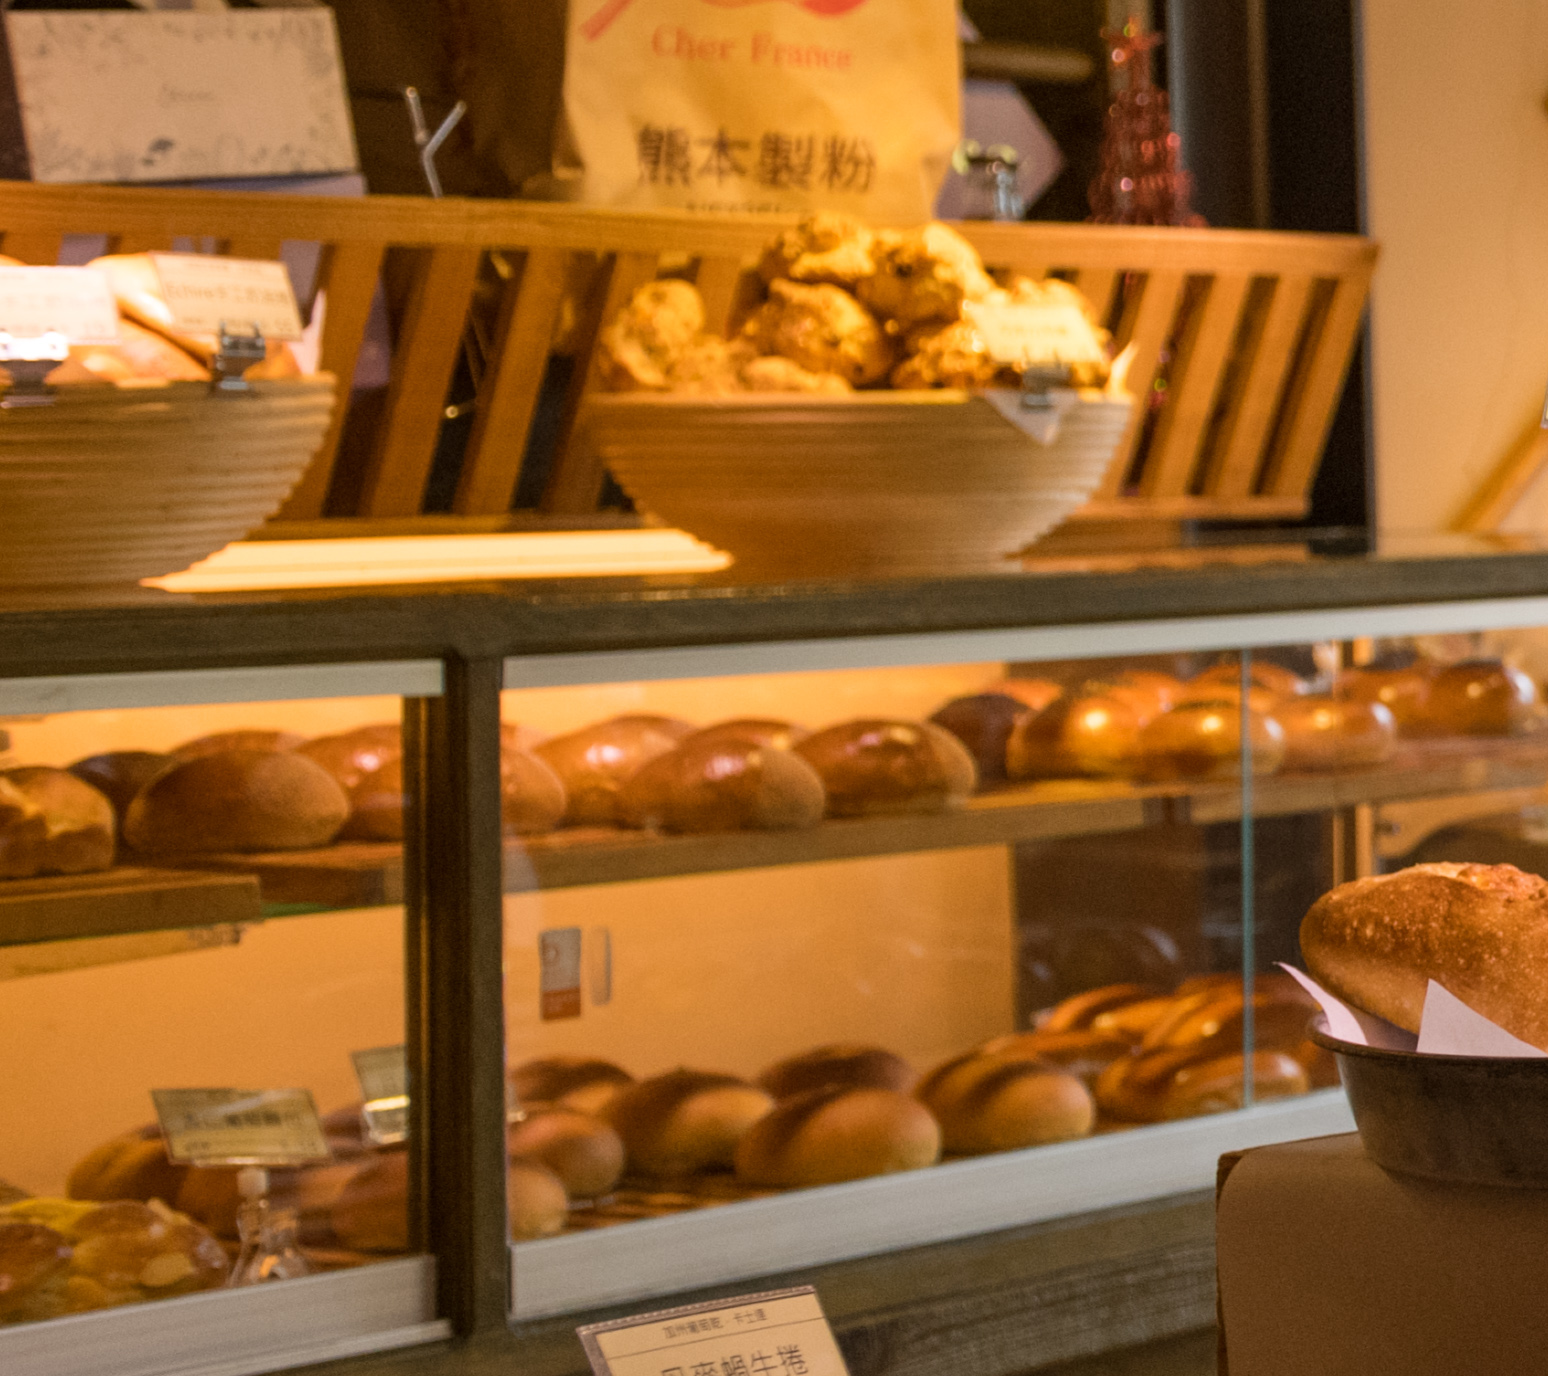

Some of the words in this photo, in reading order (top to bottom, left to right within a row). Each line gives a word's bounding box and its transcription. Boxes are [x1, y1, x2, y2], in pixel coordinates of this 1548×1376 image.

[750, 29, 852, 70] France
[636, 124, 878, 192] 熊本製粉
